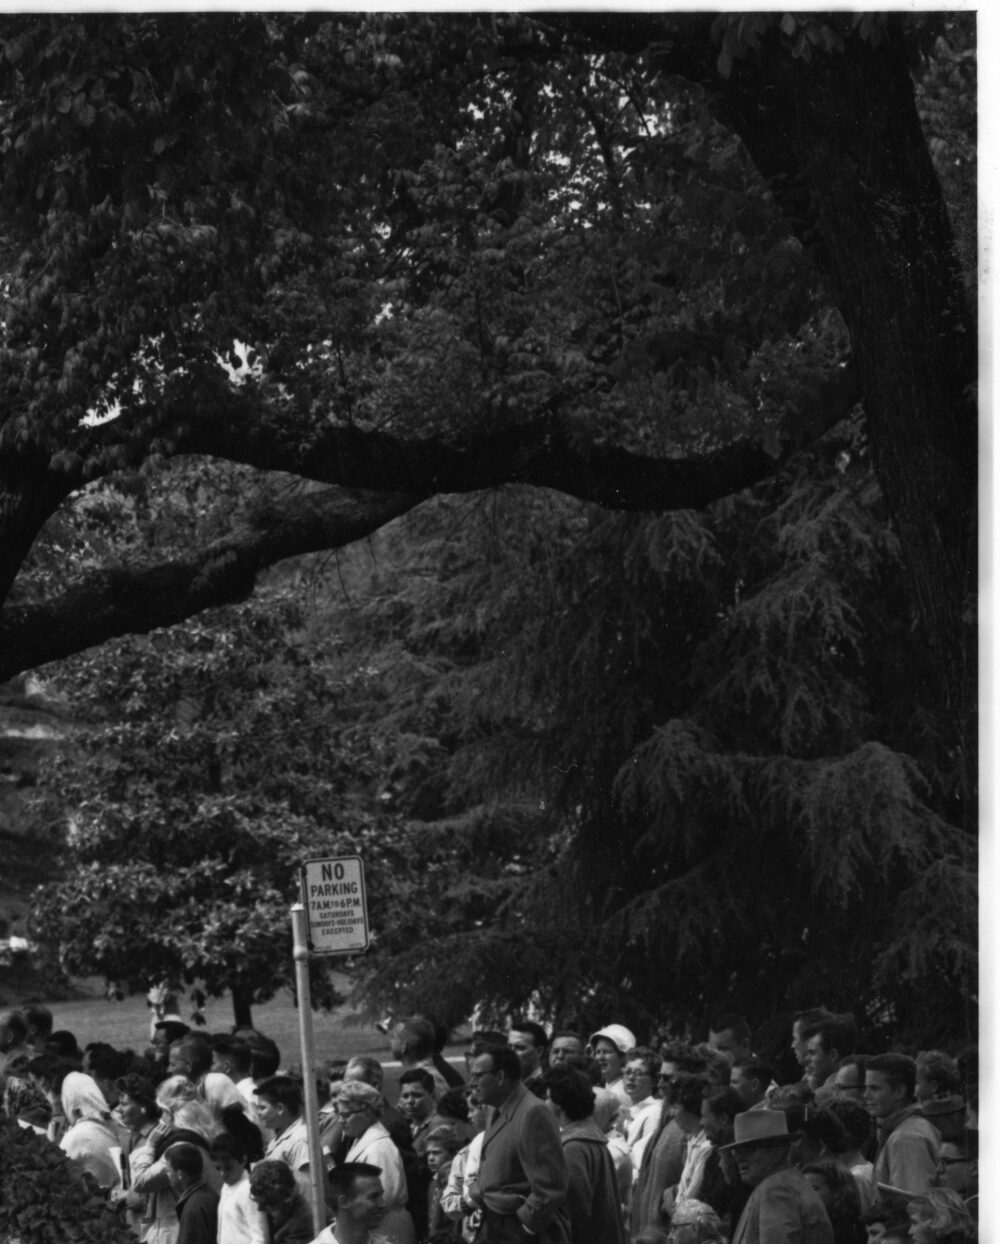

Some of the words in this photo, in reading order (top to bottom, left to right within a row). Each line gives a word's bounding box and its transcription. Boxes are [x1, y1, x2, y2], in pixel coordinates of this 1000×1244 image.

[322, 863, 345, 881] NO
[311, 882, 358, 897] PARKING
[320, 910, 354, 919] SATURDAYS
[322, 927, 354, 936] EXCEPTED
